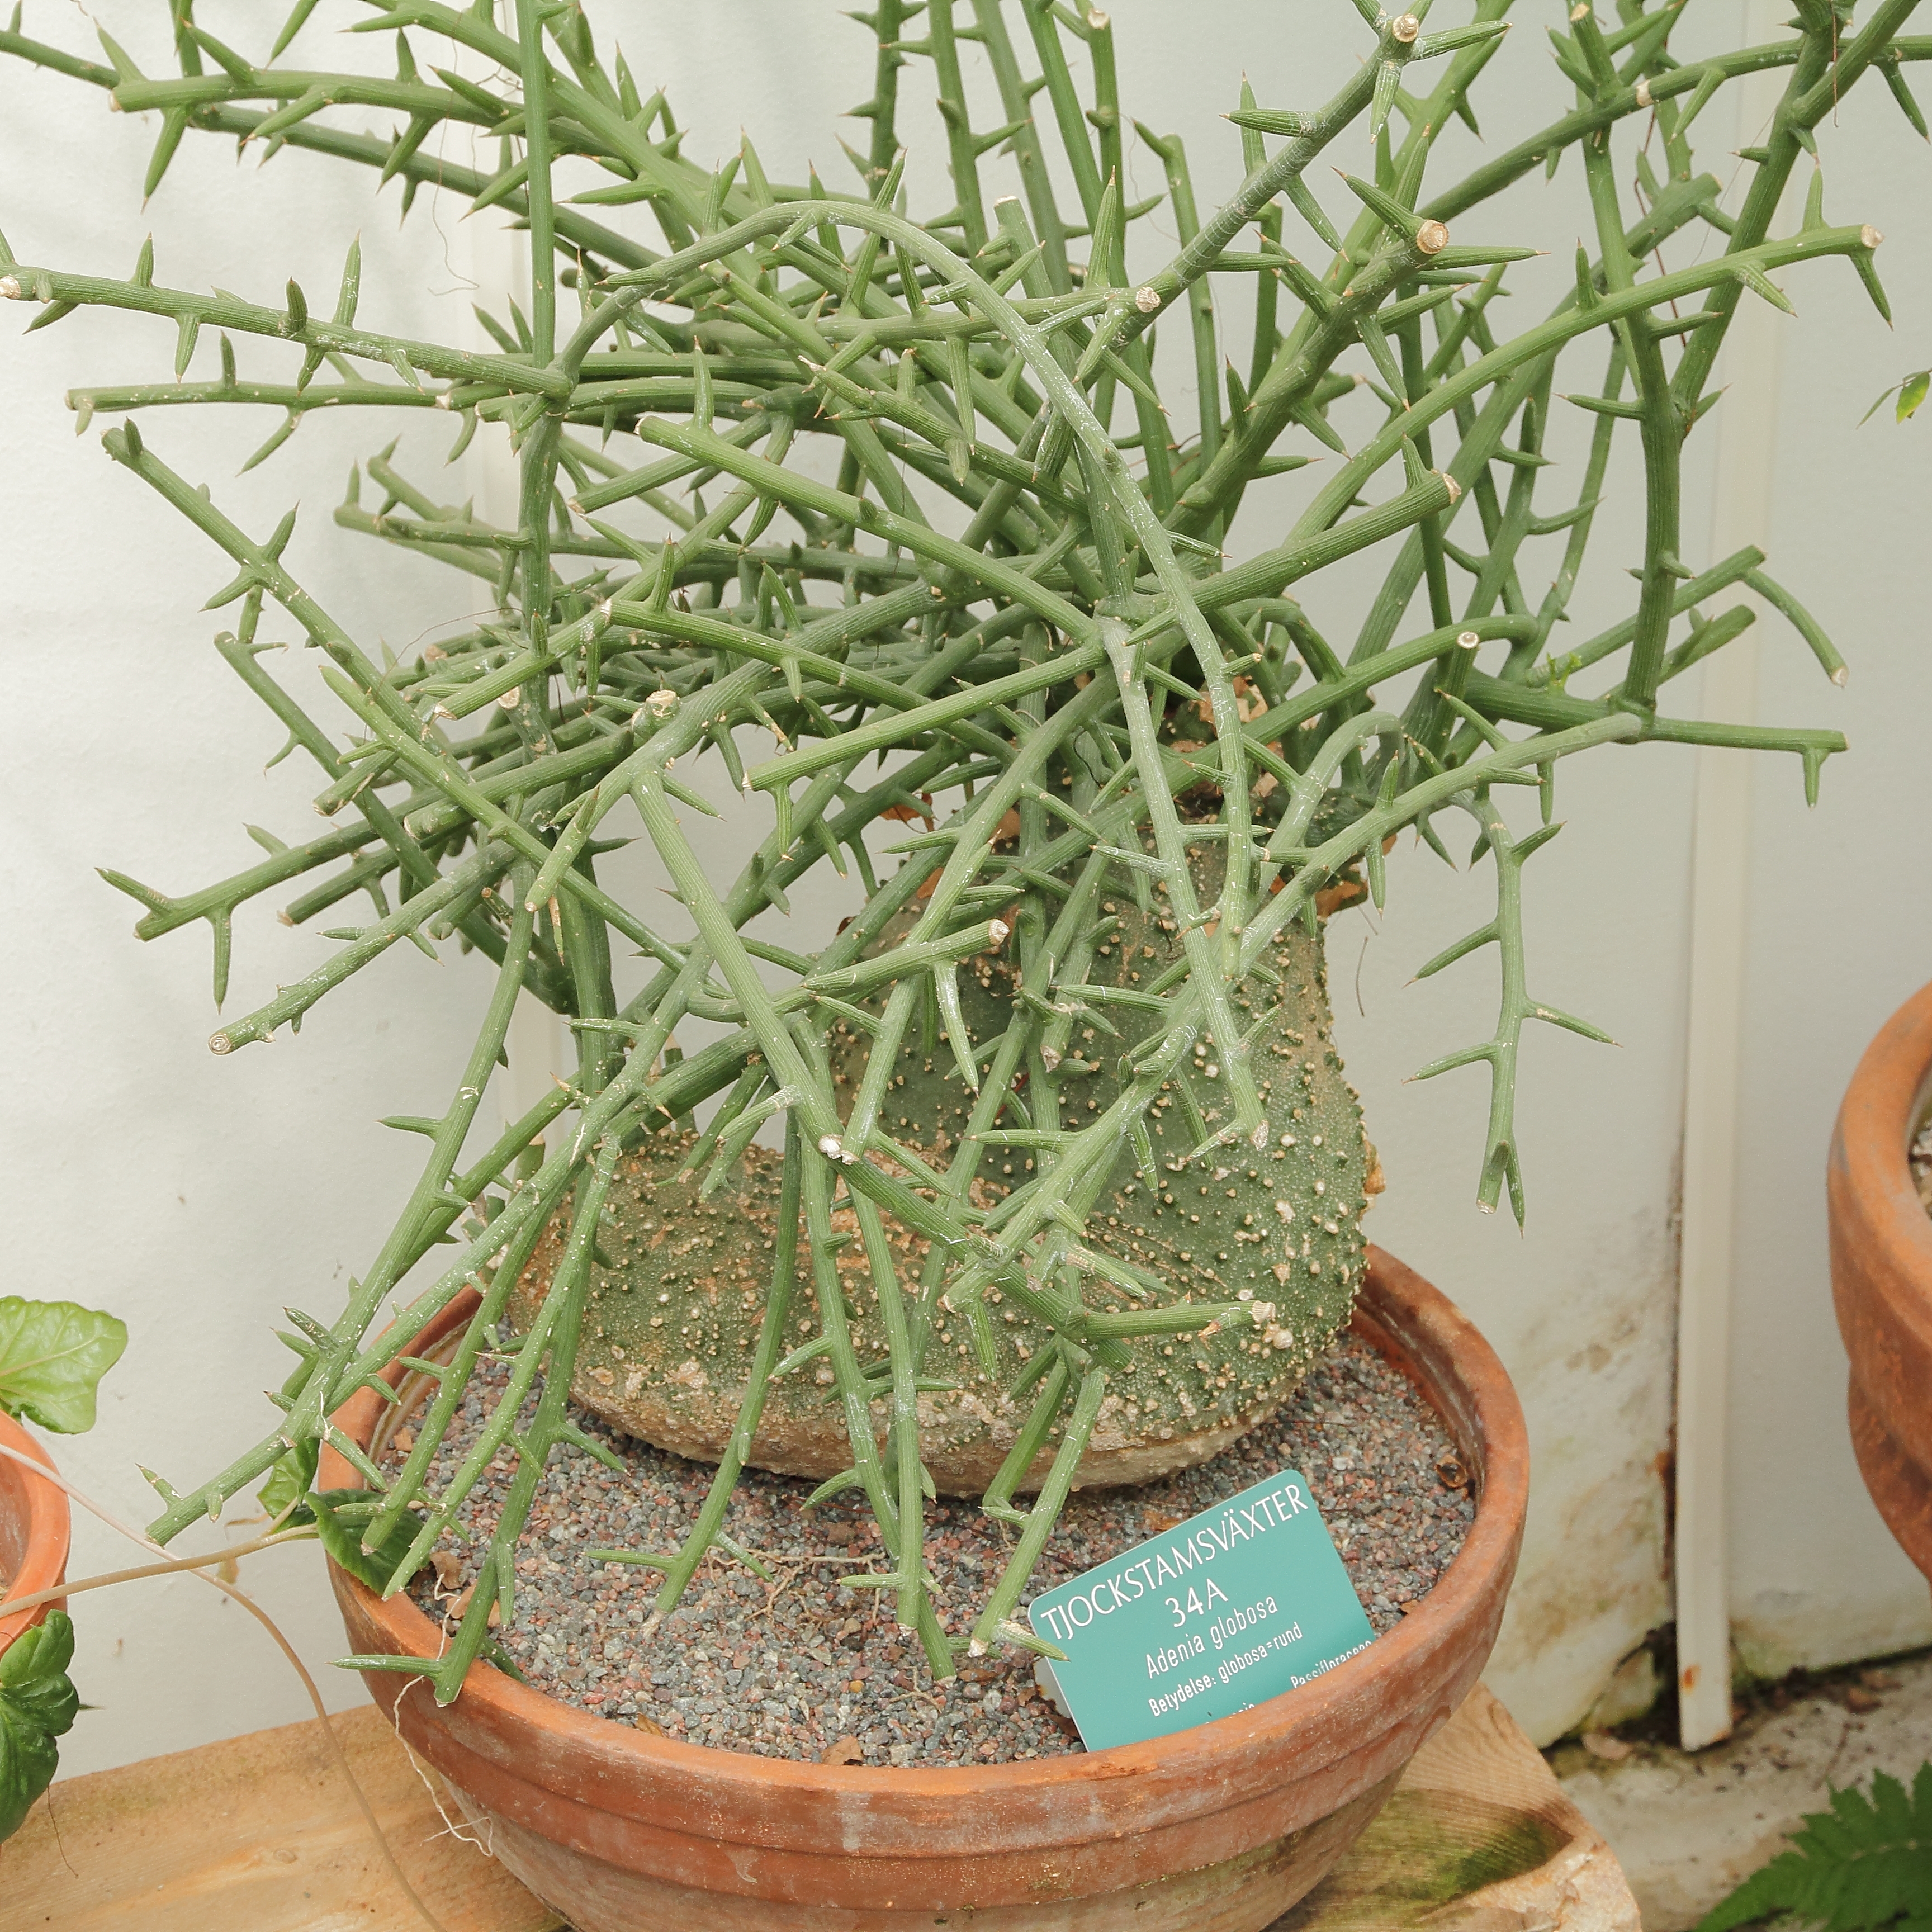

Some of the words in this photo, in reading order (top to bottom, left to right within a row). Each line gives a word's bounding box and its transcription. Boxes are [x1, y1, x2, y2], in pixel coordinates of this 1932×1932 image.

[1040, 1485, 1308, 1640] TJOCKSTAMSVÄXTER
[1164, 1578, 1228, 1627] 34A
[1145, 1633, 1205, 1679] Adenia
[1210, 1597, 1278, 1650] globosa
[1148, 1675, 1216, 1717] Betydelse:
